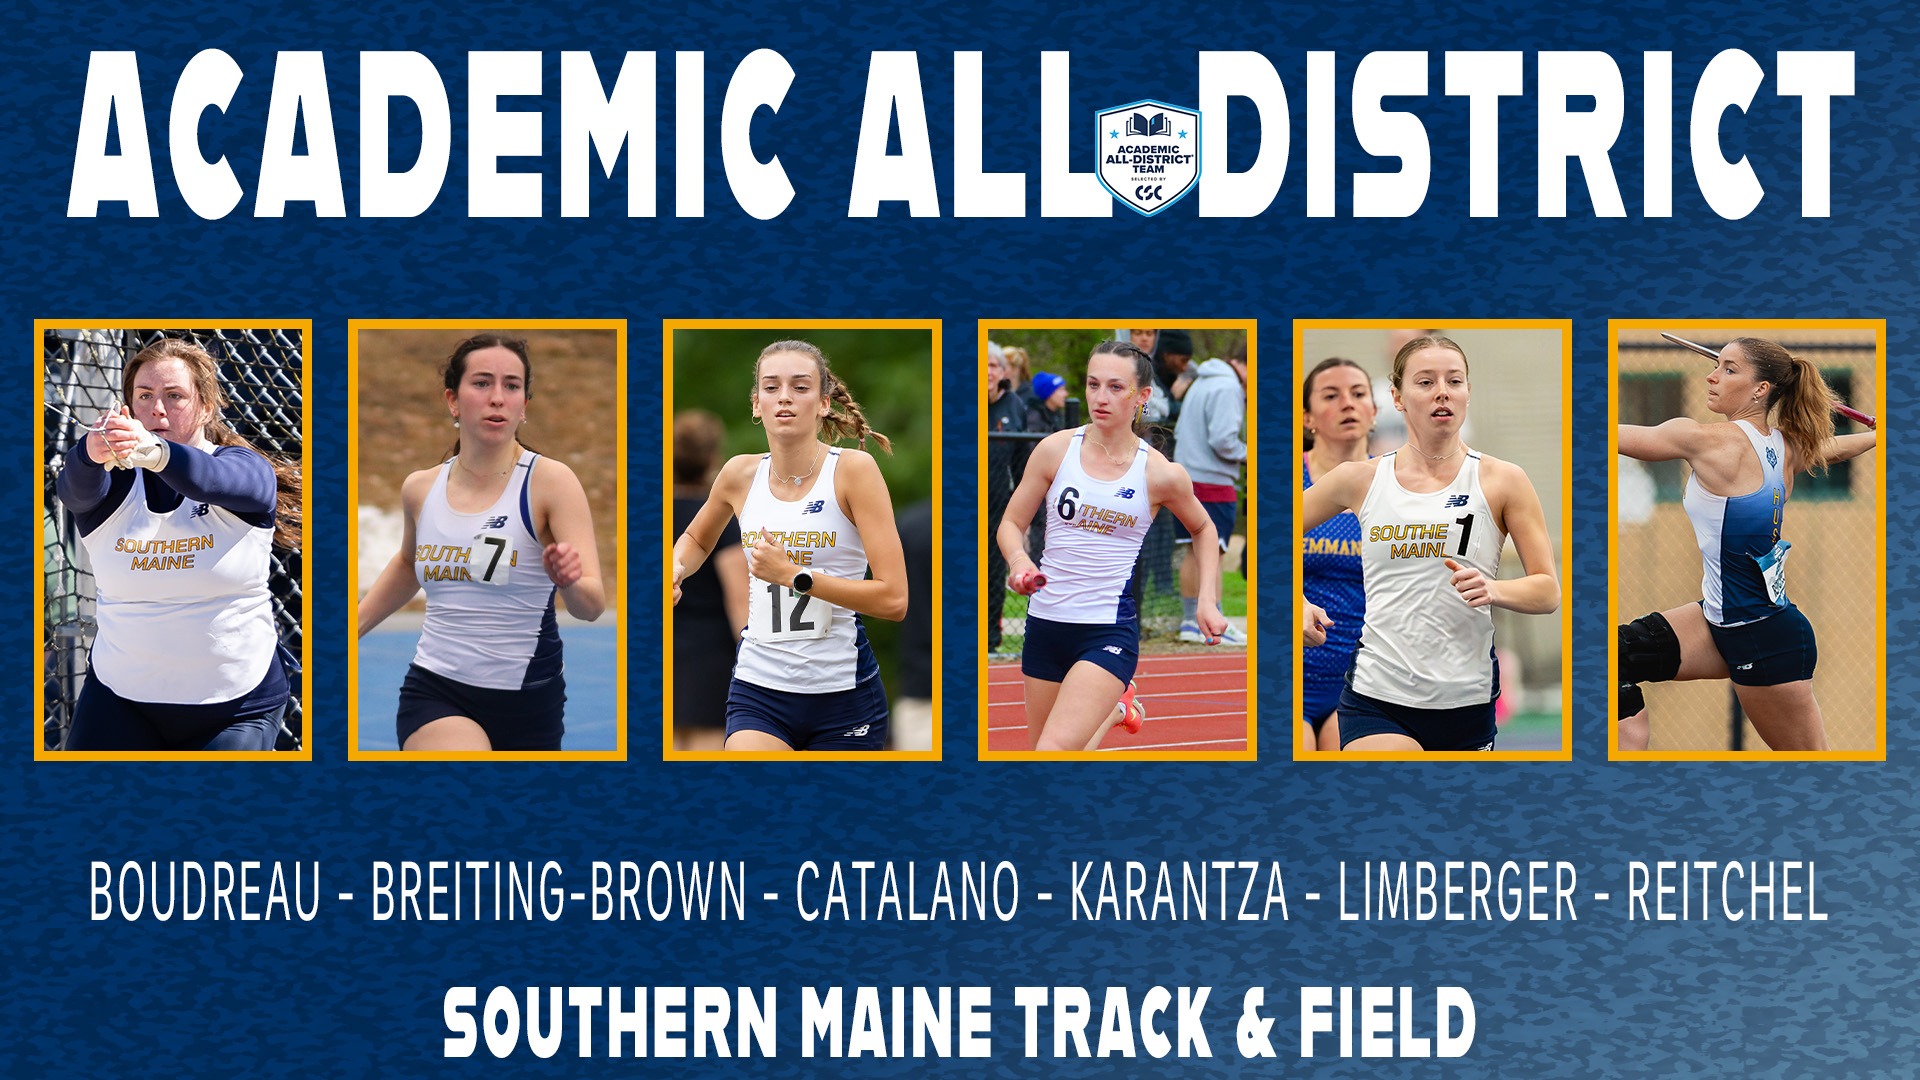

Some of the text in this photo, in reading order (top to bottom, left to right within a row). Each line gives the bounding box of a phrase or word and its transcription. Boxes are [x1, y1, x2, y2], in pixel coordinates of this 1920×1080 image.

[1057, 486, 1080, 521] 6
[1066, 518, 1117, 536] AINE
[1369, 523, 1450, 542] SOUTHE
[1455, 513, 1475, 557] 1
[114, 533, 215, 554] SOUTHERN
[130, 554, 196, 571] MAINE
[482, 536, 507, 582] 7
[423, 564, 474, 582] MAIN
[766, 583, 815, 633] 12
